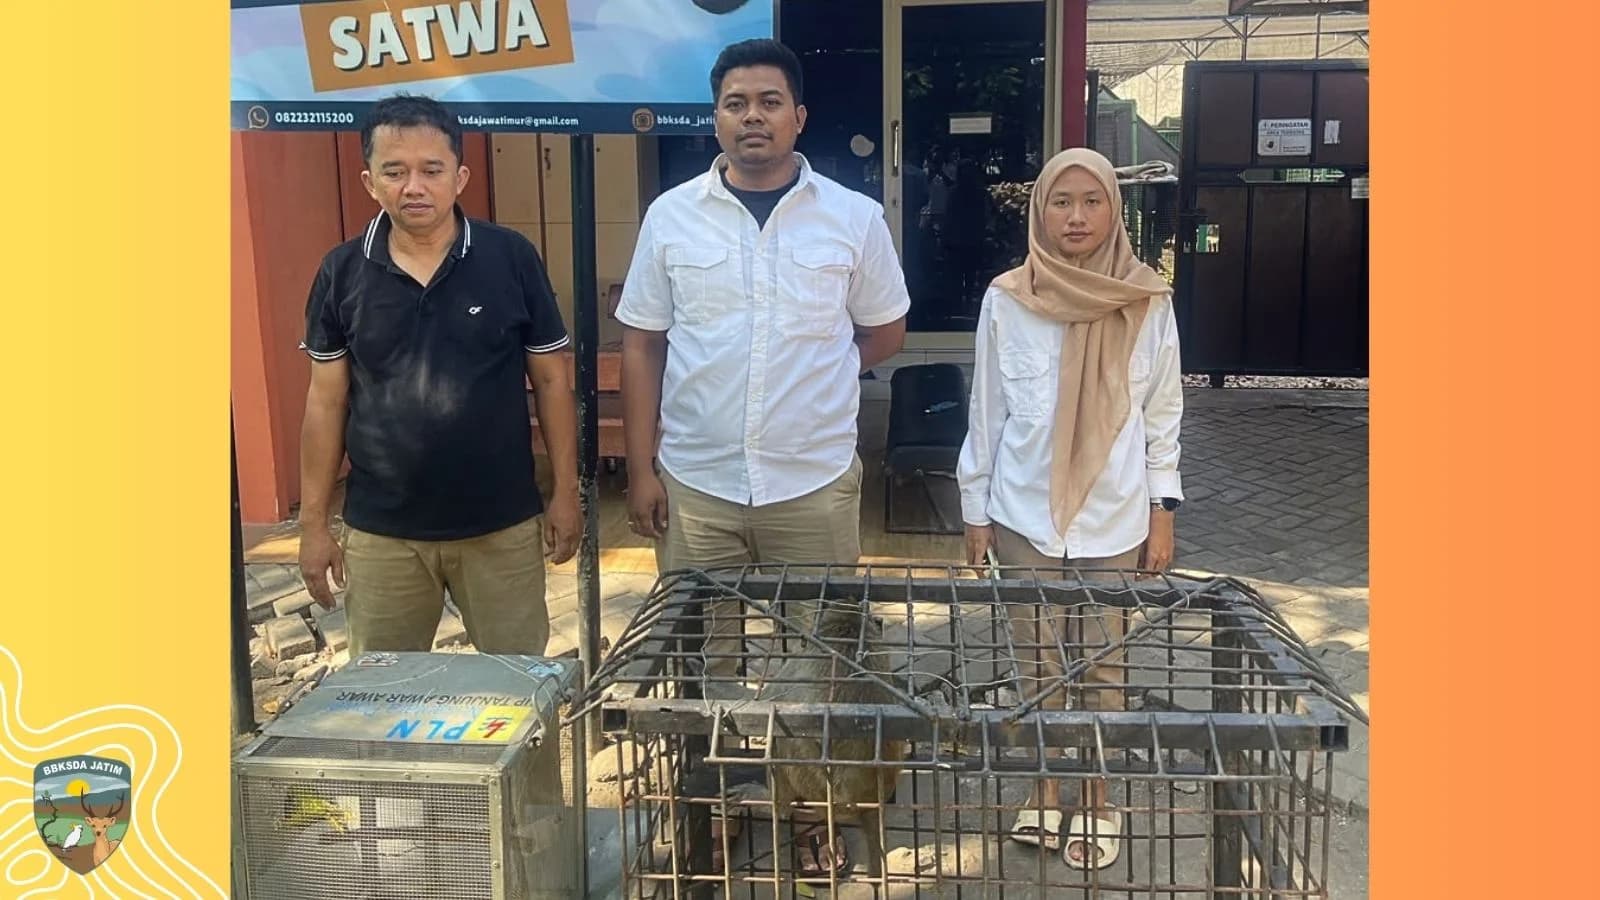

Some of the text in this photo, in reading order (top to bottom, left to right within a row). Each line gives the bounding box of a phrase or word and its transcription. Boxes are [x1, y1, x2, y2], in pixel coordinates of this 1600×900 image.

[329, 0, 548, 70] SATWA
[275, 112, 354, 123] 082232115200
[335, 691, 386, 702] AWAR
[385, 693, 438, 704] AWAR
[436, 694, 510, 705] TANJUNG
[385, 719, 472, 740] PLN
